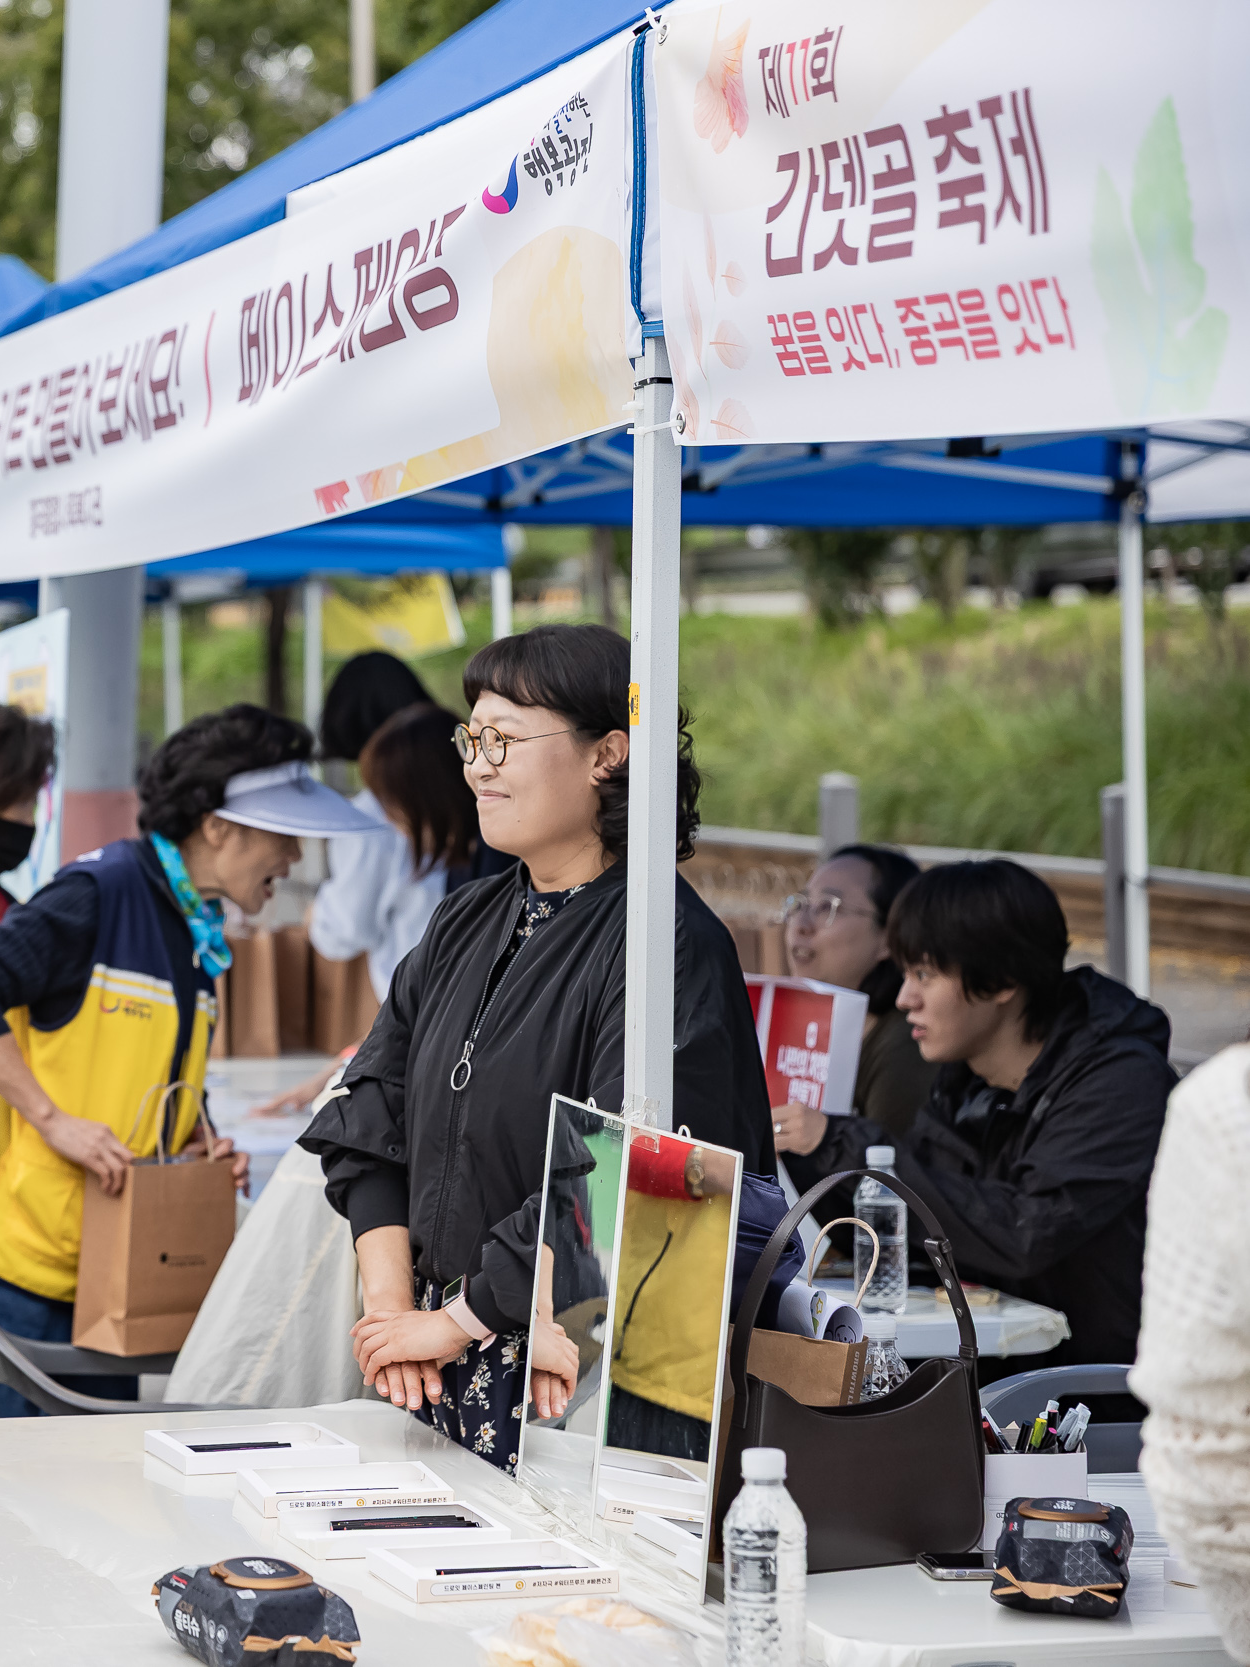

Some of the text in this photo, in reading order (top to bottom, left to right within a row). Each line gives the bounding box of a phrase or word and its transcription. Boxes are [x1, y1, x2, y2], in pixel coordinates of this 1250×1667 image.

[757, 25, 844, 119] 제11회
[765, 87, 1050, 278] 간뎃골 축제
[767, 276, 1076, 377] 꿈을 잇다, 중곡을 잇다
[174, 1609, 201, 1638] 물티슈
